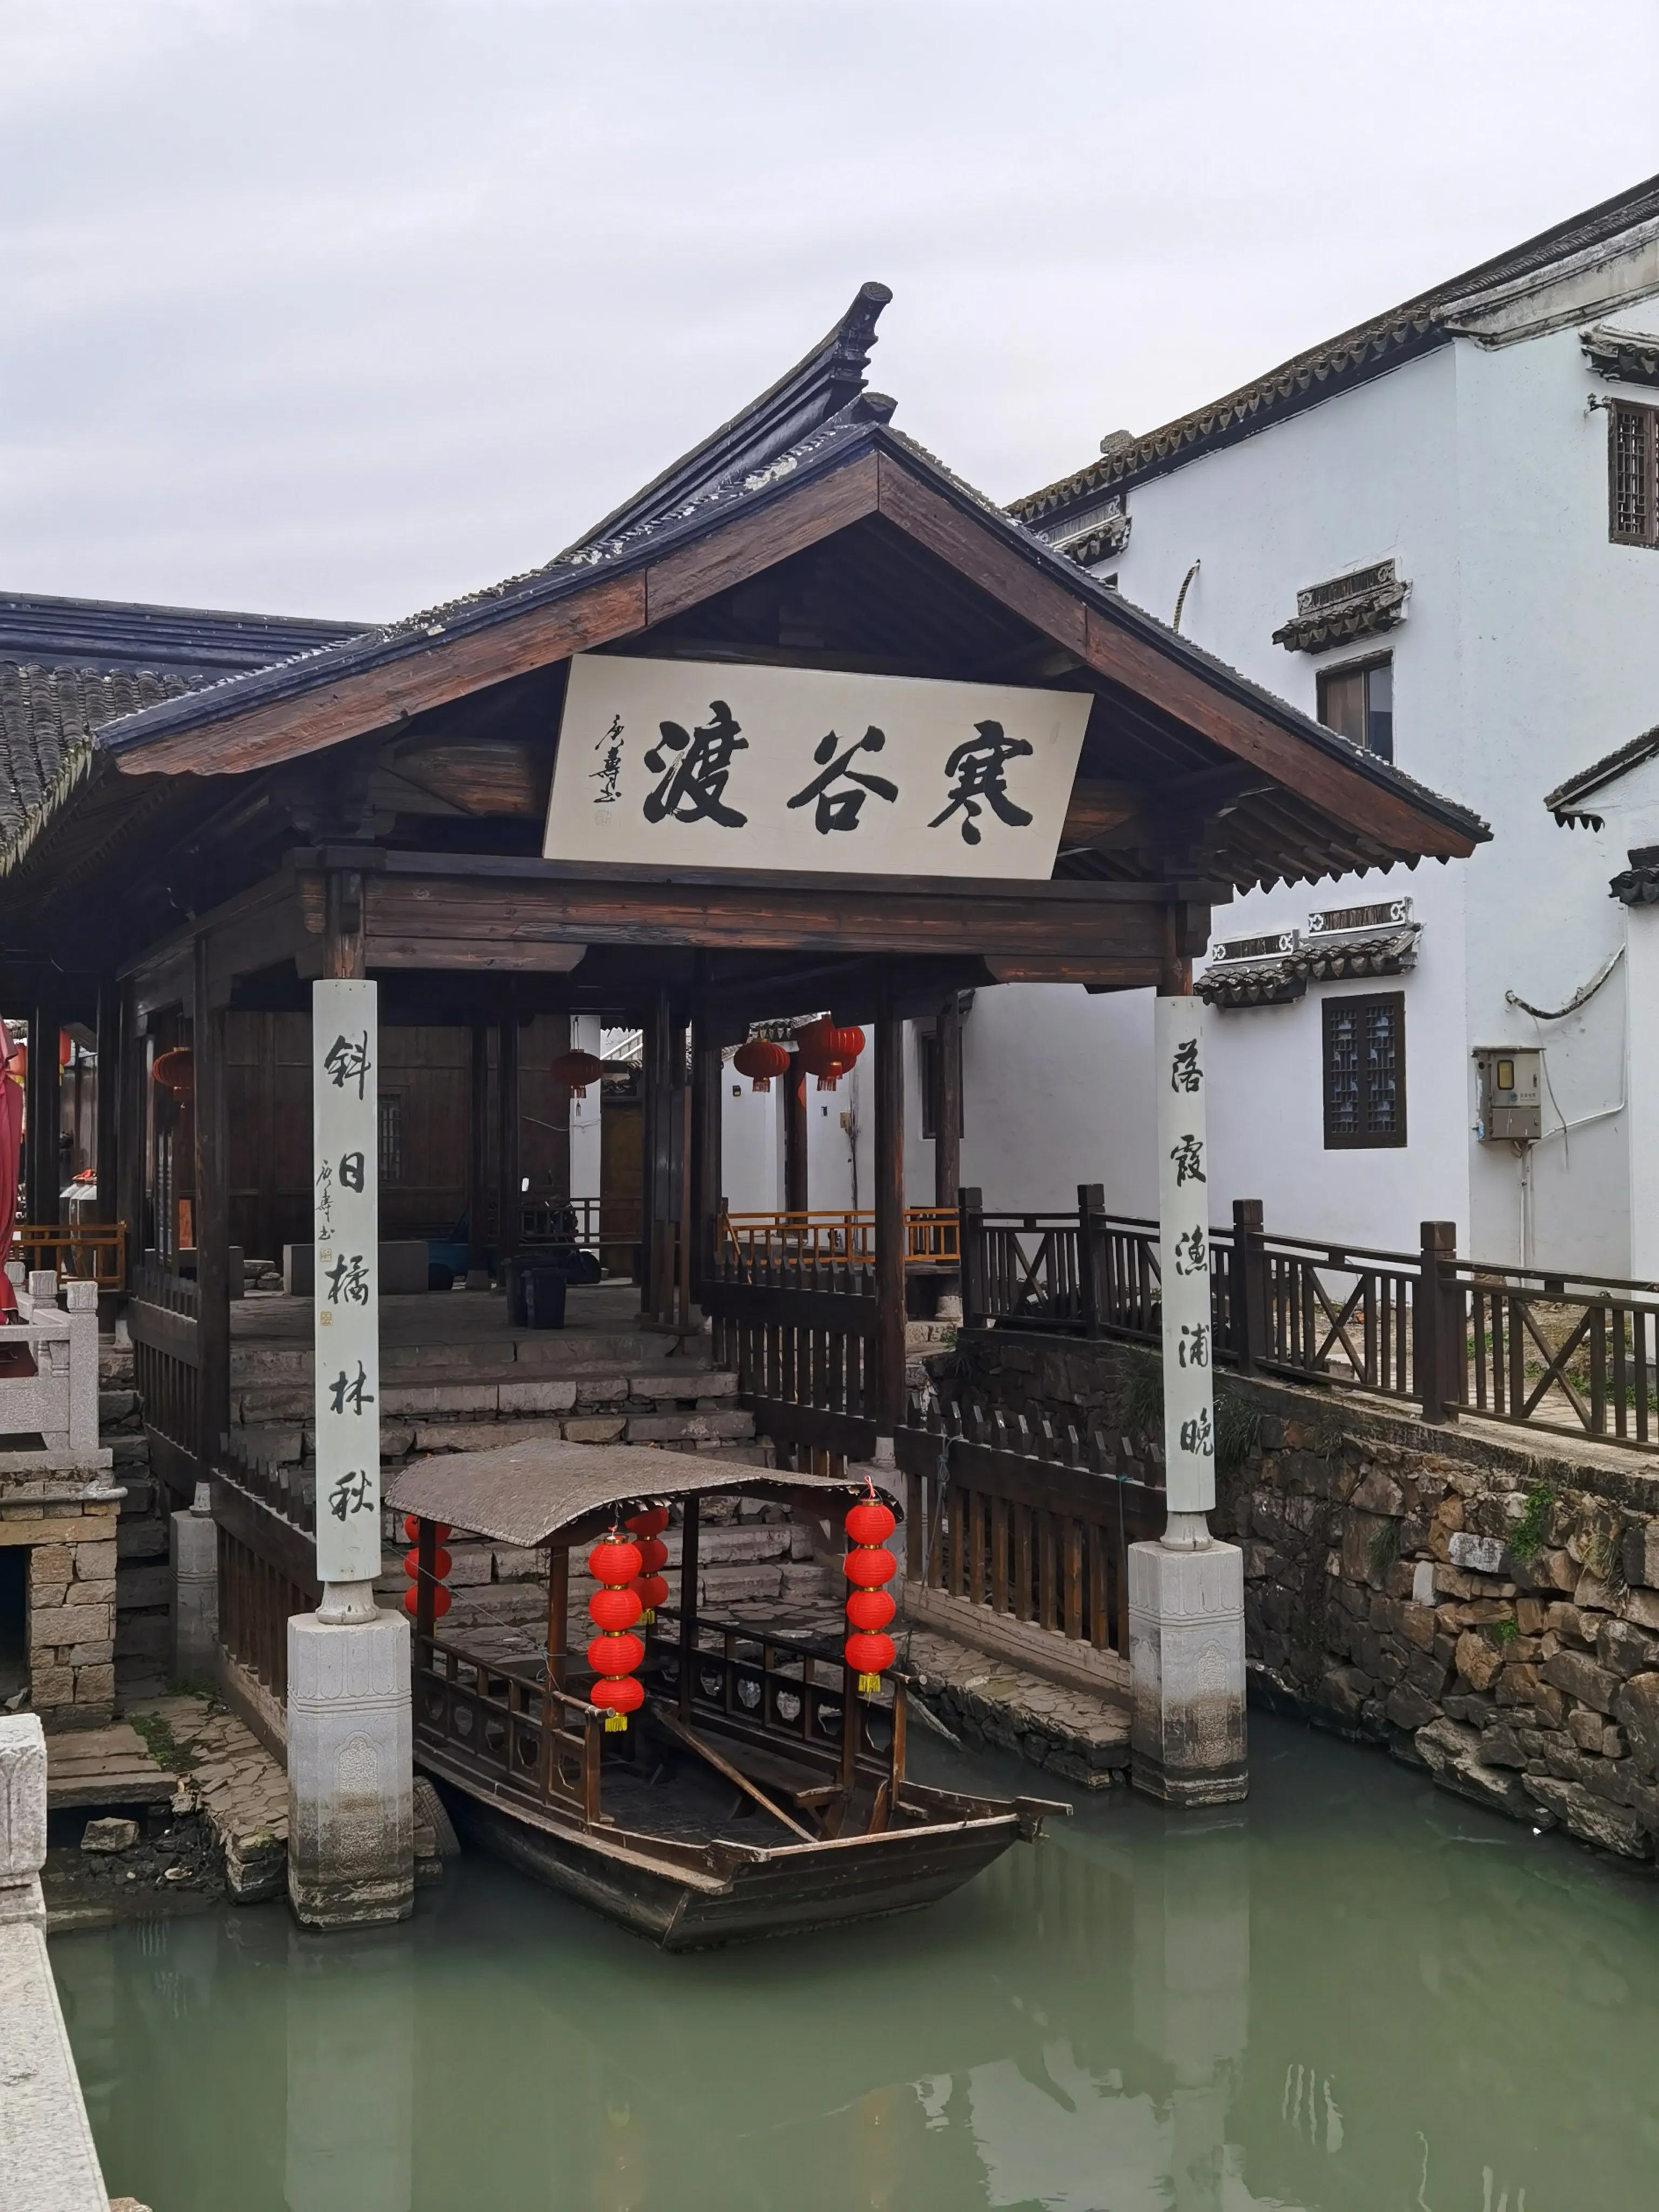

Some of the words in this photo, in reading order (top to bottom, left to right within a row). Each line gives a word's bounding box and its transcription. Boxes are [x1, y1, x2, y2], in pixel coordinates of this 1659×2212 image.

[643, 700, 1034, 845] 寒谷渡
[323, 1030, 374, 1522] 斜日橘林秋
